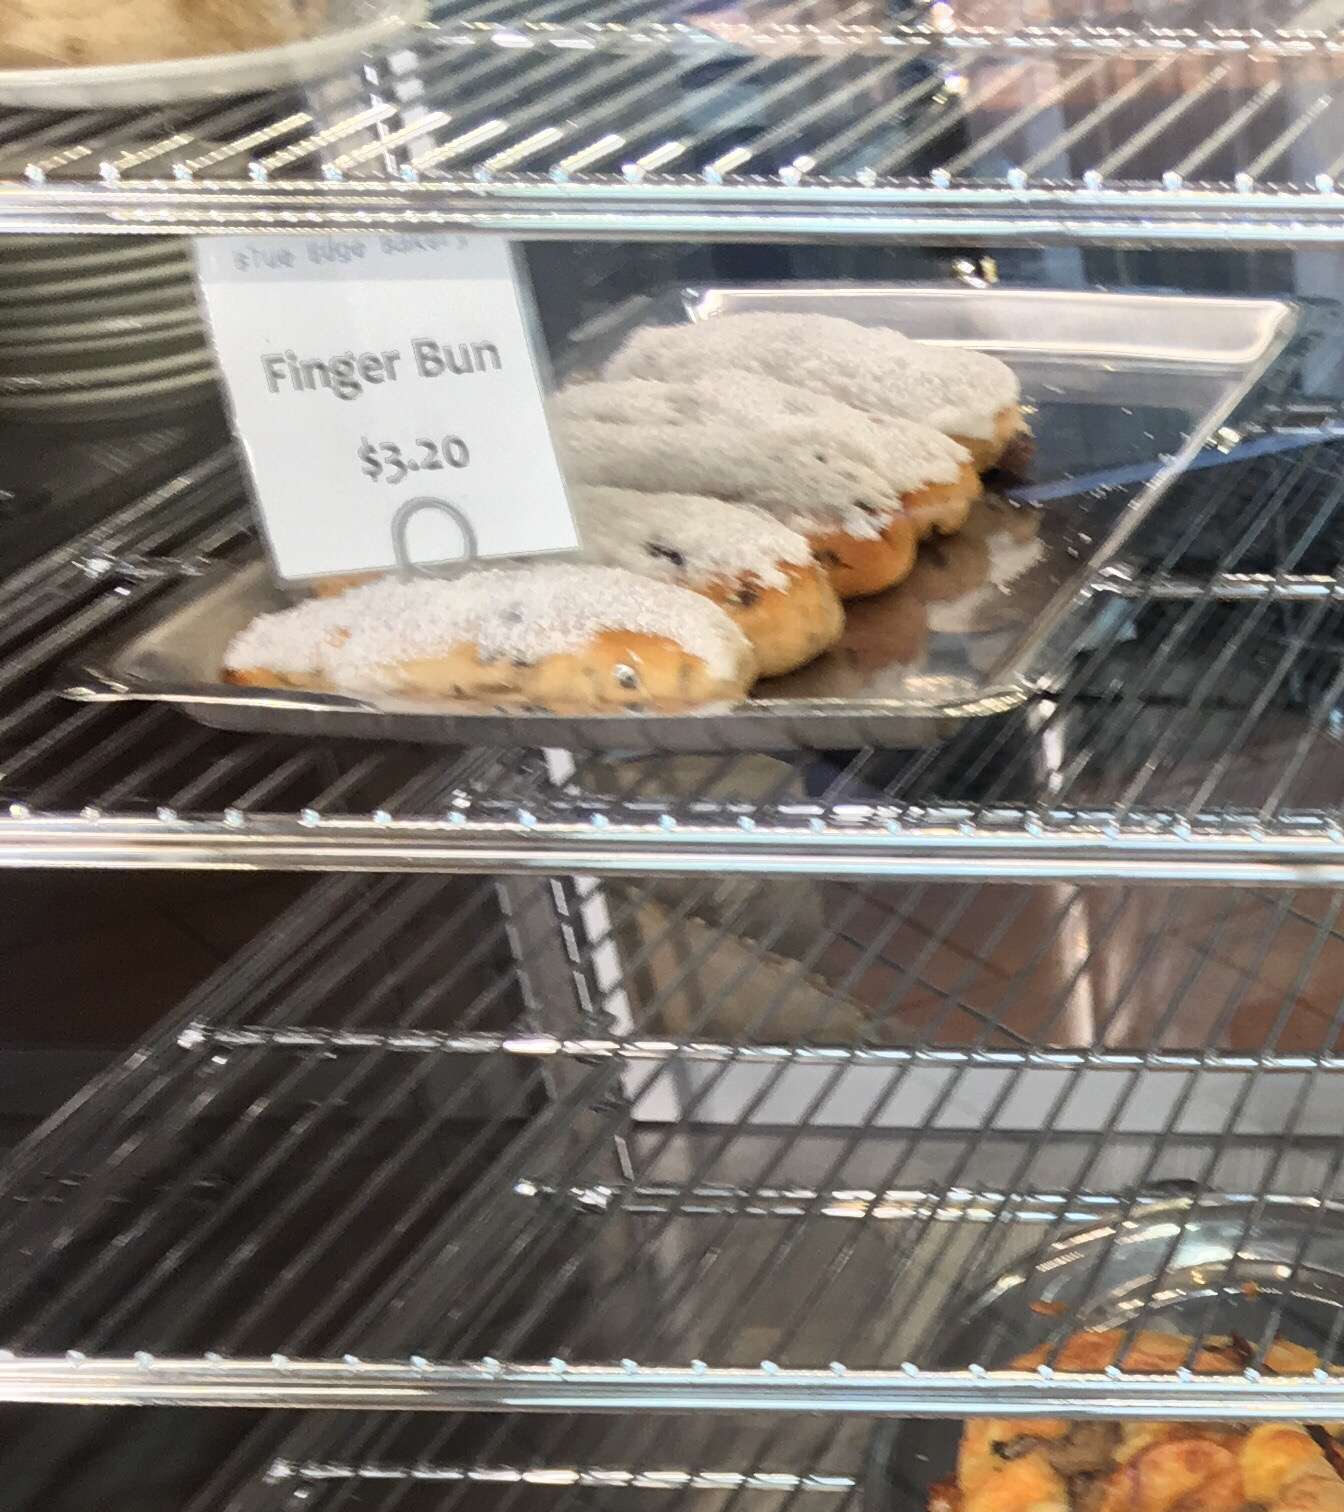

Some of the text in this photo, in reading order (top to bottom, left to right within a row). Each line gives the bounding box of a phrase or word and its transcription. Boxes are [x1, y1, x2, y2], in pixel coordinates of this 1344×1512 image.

[261, 337, 503, 400] Finger Bun
[357, 434, 471, 486] $3.20
